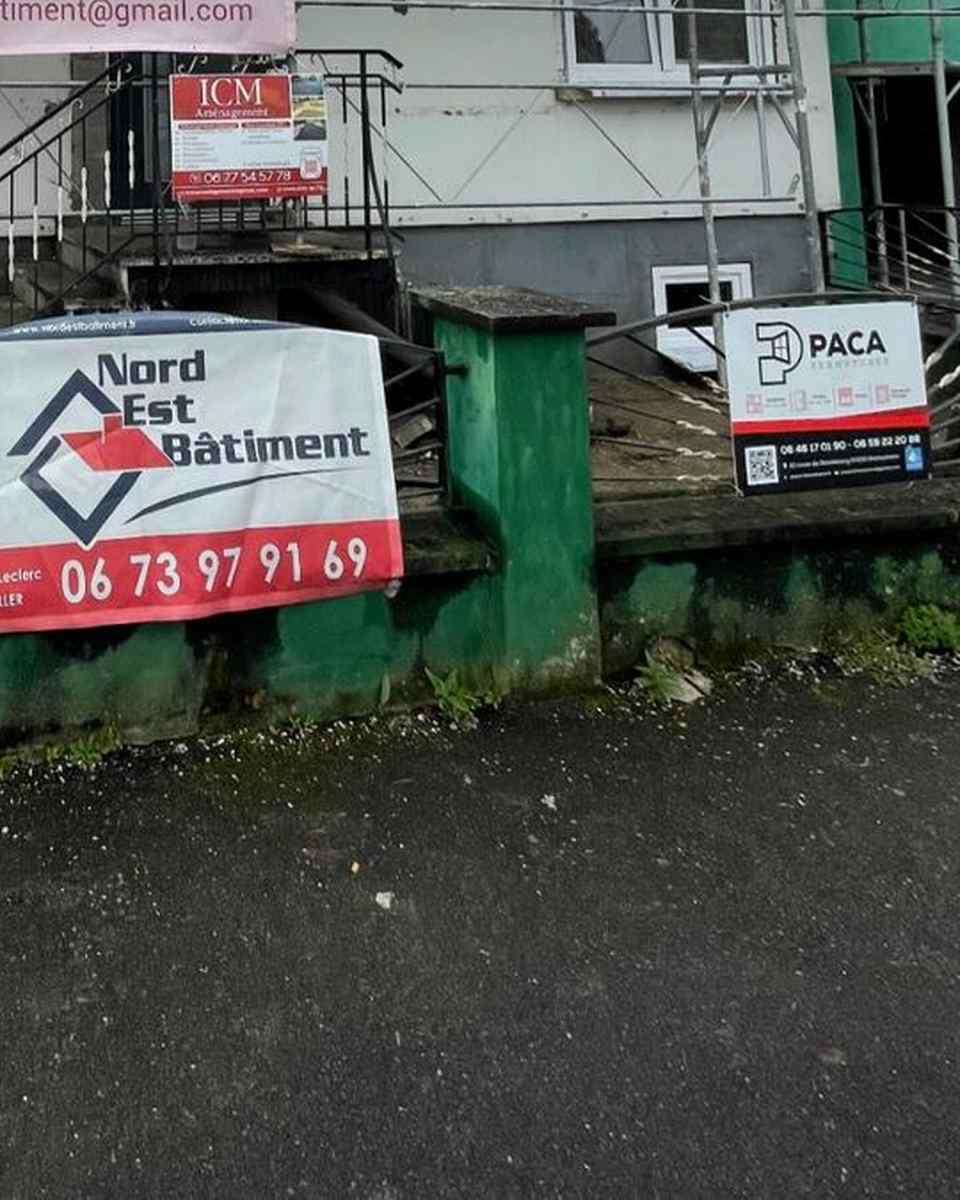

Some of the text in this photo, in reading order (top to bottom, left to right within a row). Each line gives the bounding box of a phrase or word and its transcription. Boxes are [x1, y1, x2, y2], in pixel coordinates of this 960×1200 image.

[199, 78, 263, 107] ICM
[809, 330, 887, 358] PACA
[97, 350, 206, 387] Nord
[122, 394, 197, 426] Est
[161, 427, 370, 467] Bâtiment
[60, 537, 368, 604] 06 73 97 91 69
